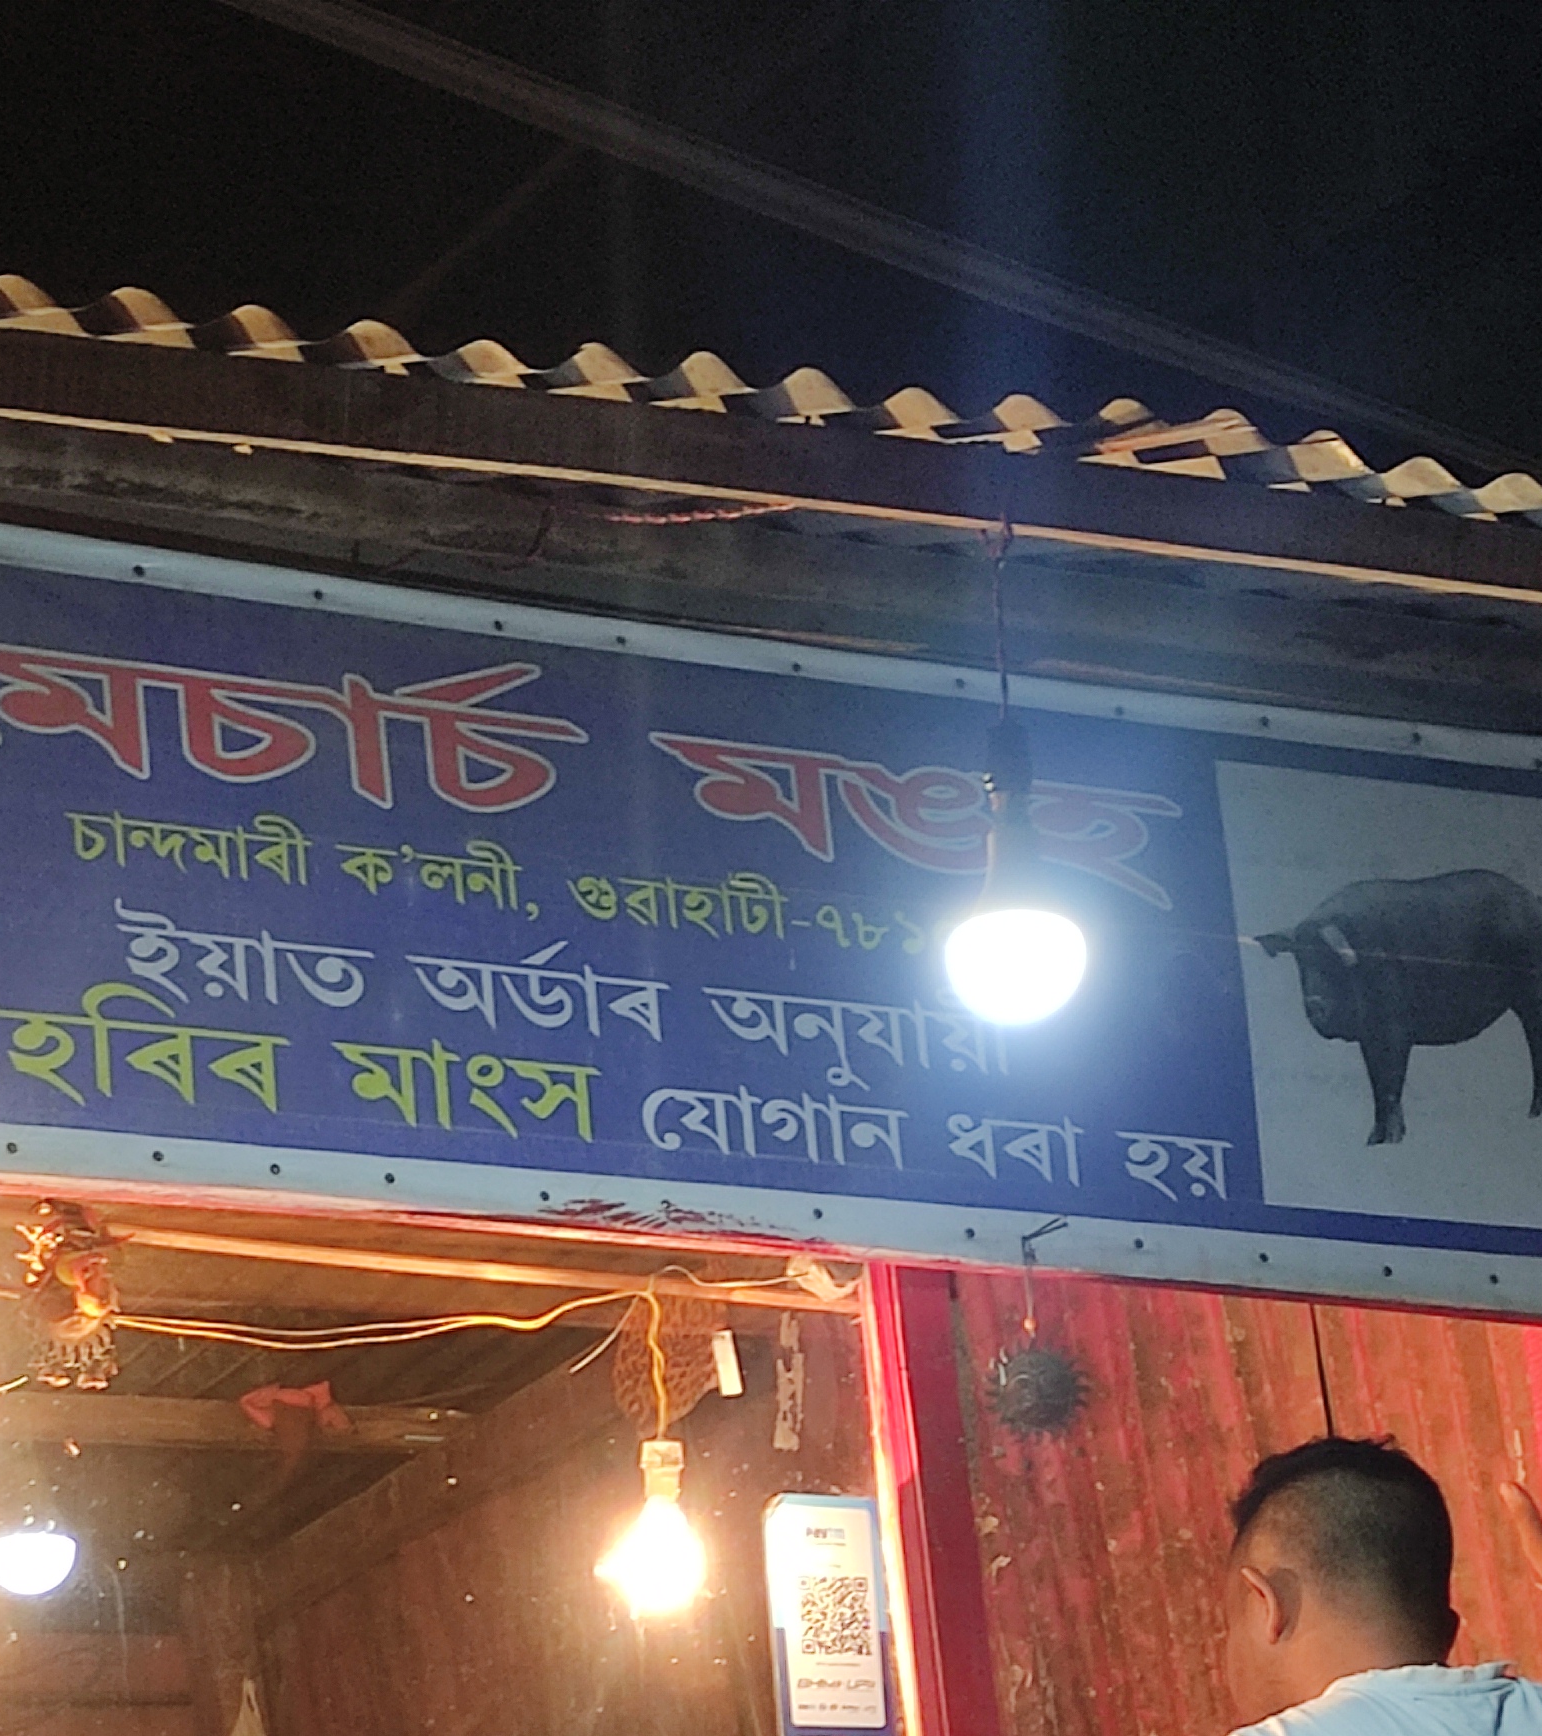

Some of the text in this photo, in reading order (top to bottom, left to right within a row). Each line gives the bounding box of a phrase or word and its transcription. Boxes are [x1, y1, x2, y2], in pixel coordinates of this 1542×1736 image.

[64, 811, 312, 886] চান্দমাৰী
[114, 897, 375, 1007] ইয়াত
[330, 1038, 602, 1143] মাংস
[641, 1084, 909, 1170] যোগান
[946, 1111, 1083, 1187] ধৰা
[1116, 1130, 1235, 1202] হয়
